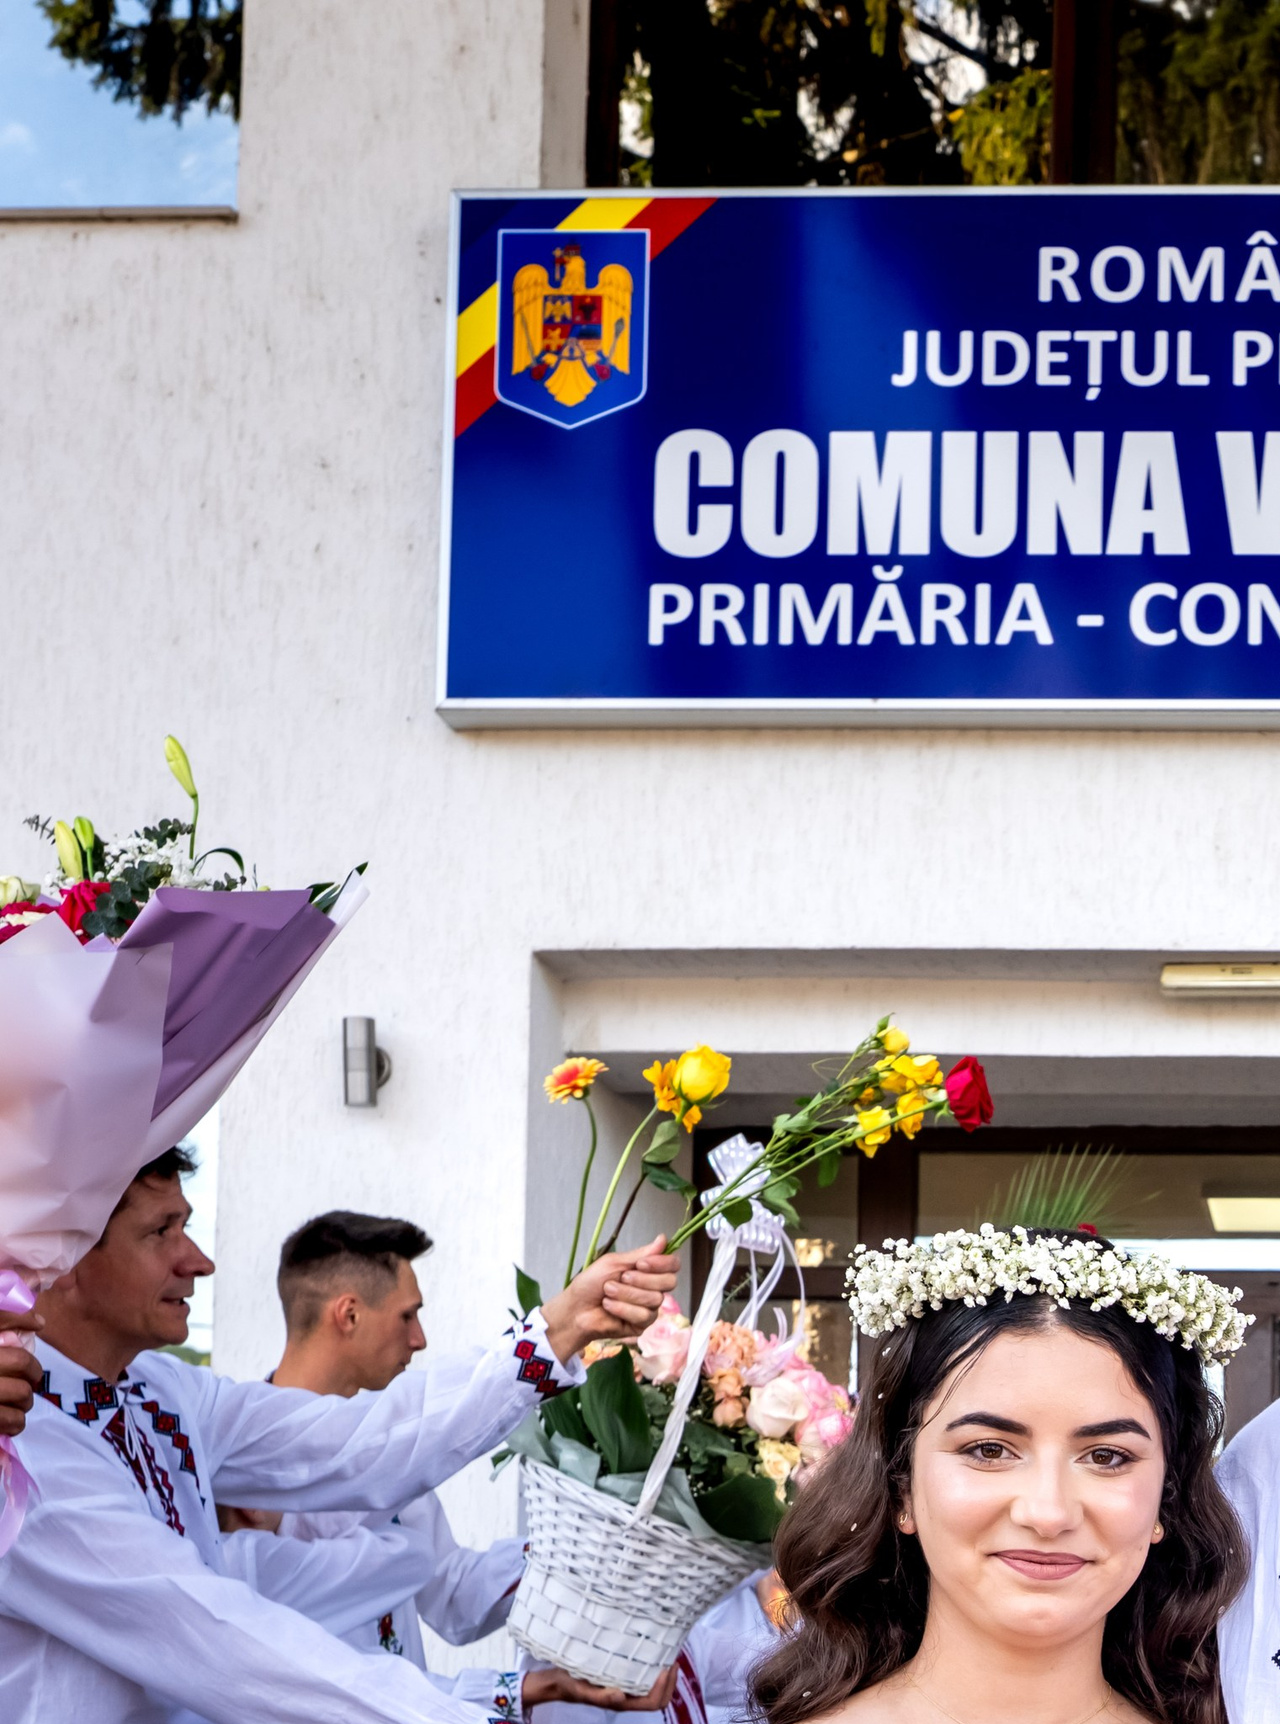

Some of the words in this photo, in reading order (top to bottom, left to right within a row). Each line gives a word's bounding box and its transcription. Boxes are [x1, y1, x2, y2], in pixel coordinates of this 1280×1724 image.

[892, 330, 1209, 400] JUDEȚUL
[654, 429, 1190, 557] COMUNA
[649, 565, 1054, 645] PRIMĂRIA
